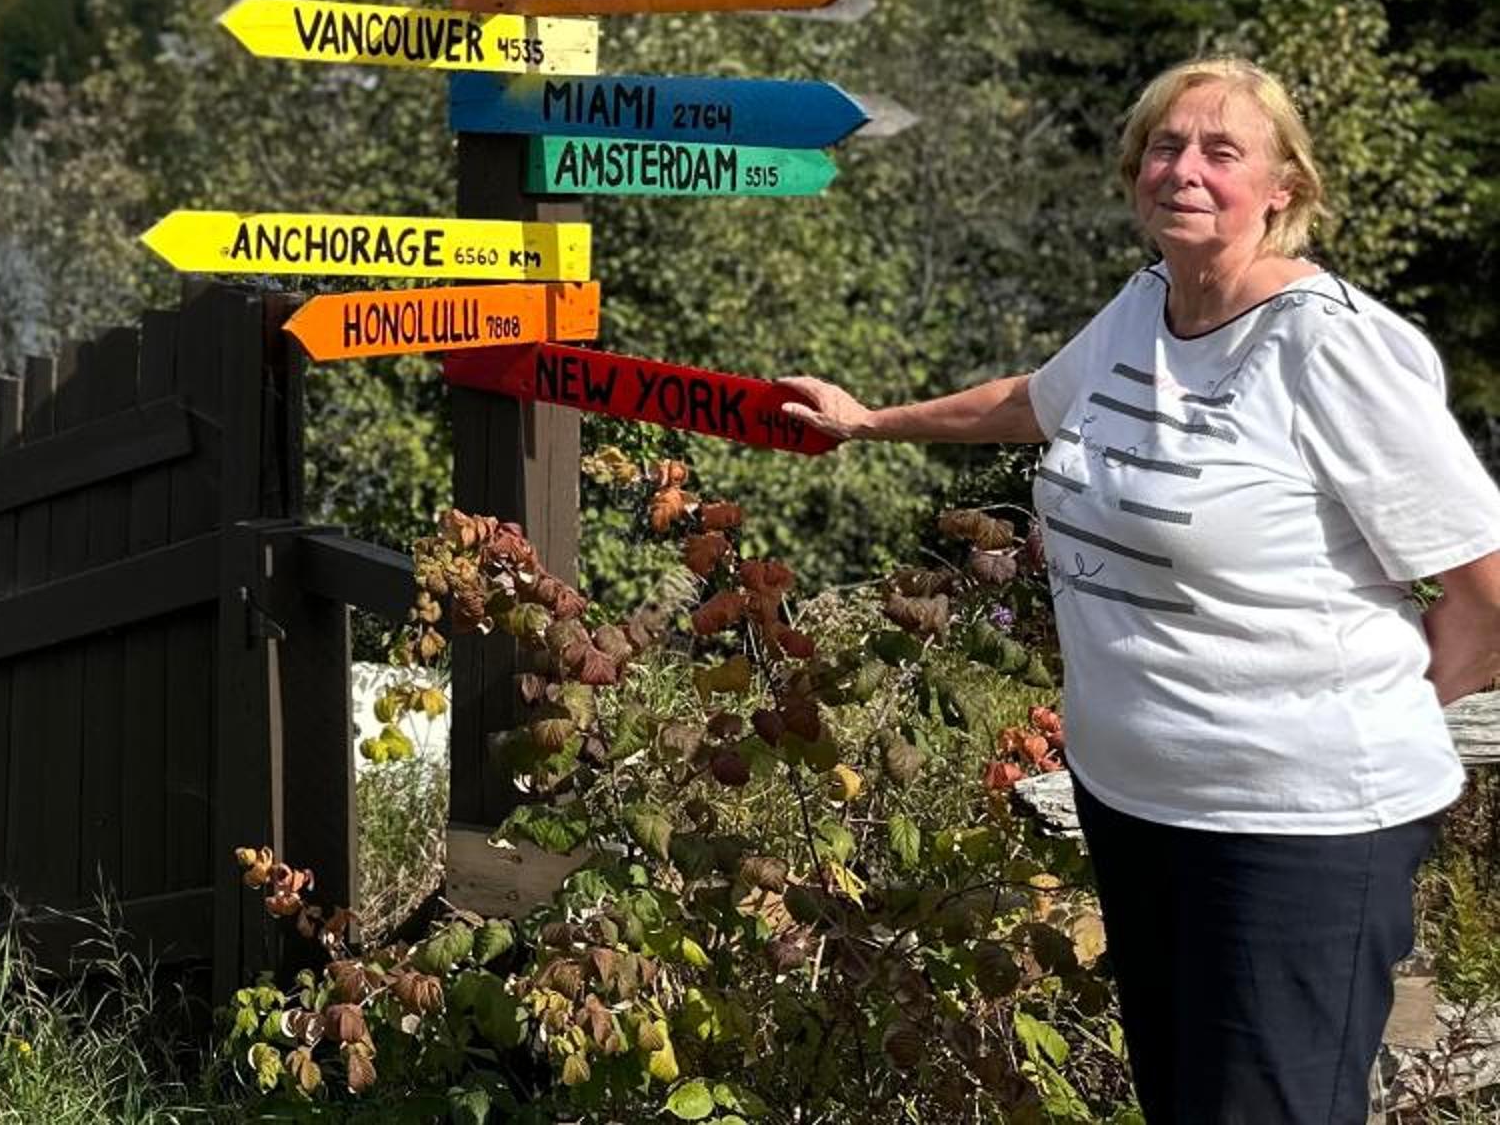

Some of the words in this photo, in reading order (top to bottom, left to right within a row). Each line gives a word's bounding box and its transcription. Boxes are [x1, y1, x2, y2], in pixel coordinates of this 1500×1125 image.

[294, 7, 484, 62] VANCOUVER
[497, 37, 544, 65] 4535
[544, 80, 656, 130] MIAMI
[673, 105, 732, 132] 2764
[554, 140, 737, 192] AMSTERDAM
[745, 166, 778, 187] 5515
[231, 223, 445, 266] ANCHORAGE
[454, 248, 498, 266] 6560
[509, 249, 542, 267] KM
[343, 298, 479, 348] HONOLULU
[534, 352, 616, 404] NEW
[635, 367, 747, 435] YORK
